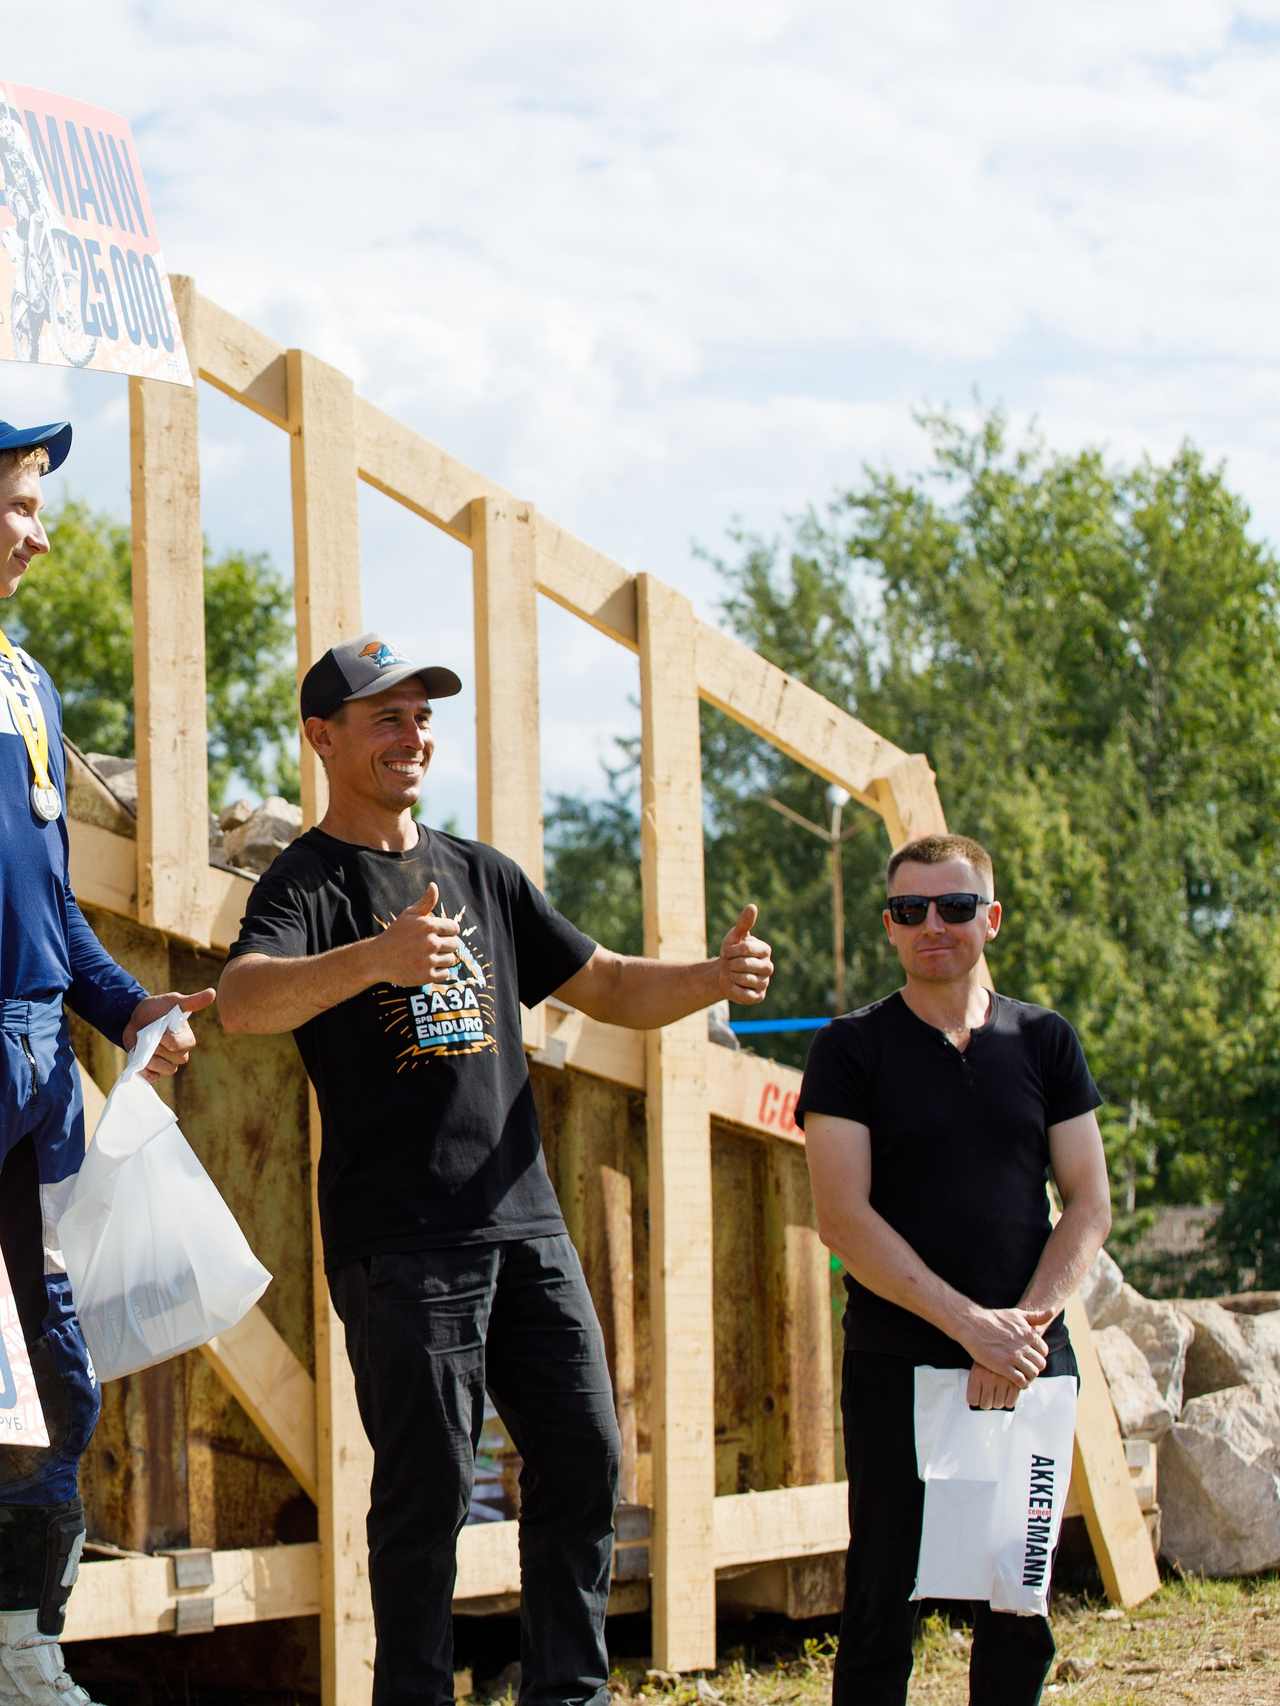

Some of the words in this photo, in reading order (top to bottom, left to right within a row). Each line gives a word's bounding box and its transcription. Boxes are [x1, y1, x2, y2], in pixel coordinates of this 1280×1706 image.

[410, 988, 479, 1016] БАЗА
[415, 1015, 434, 1024] SPB
[416, 1017, 484, 1039] ENDURO
